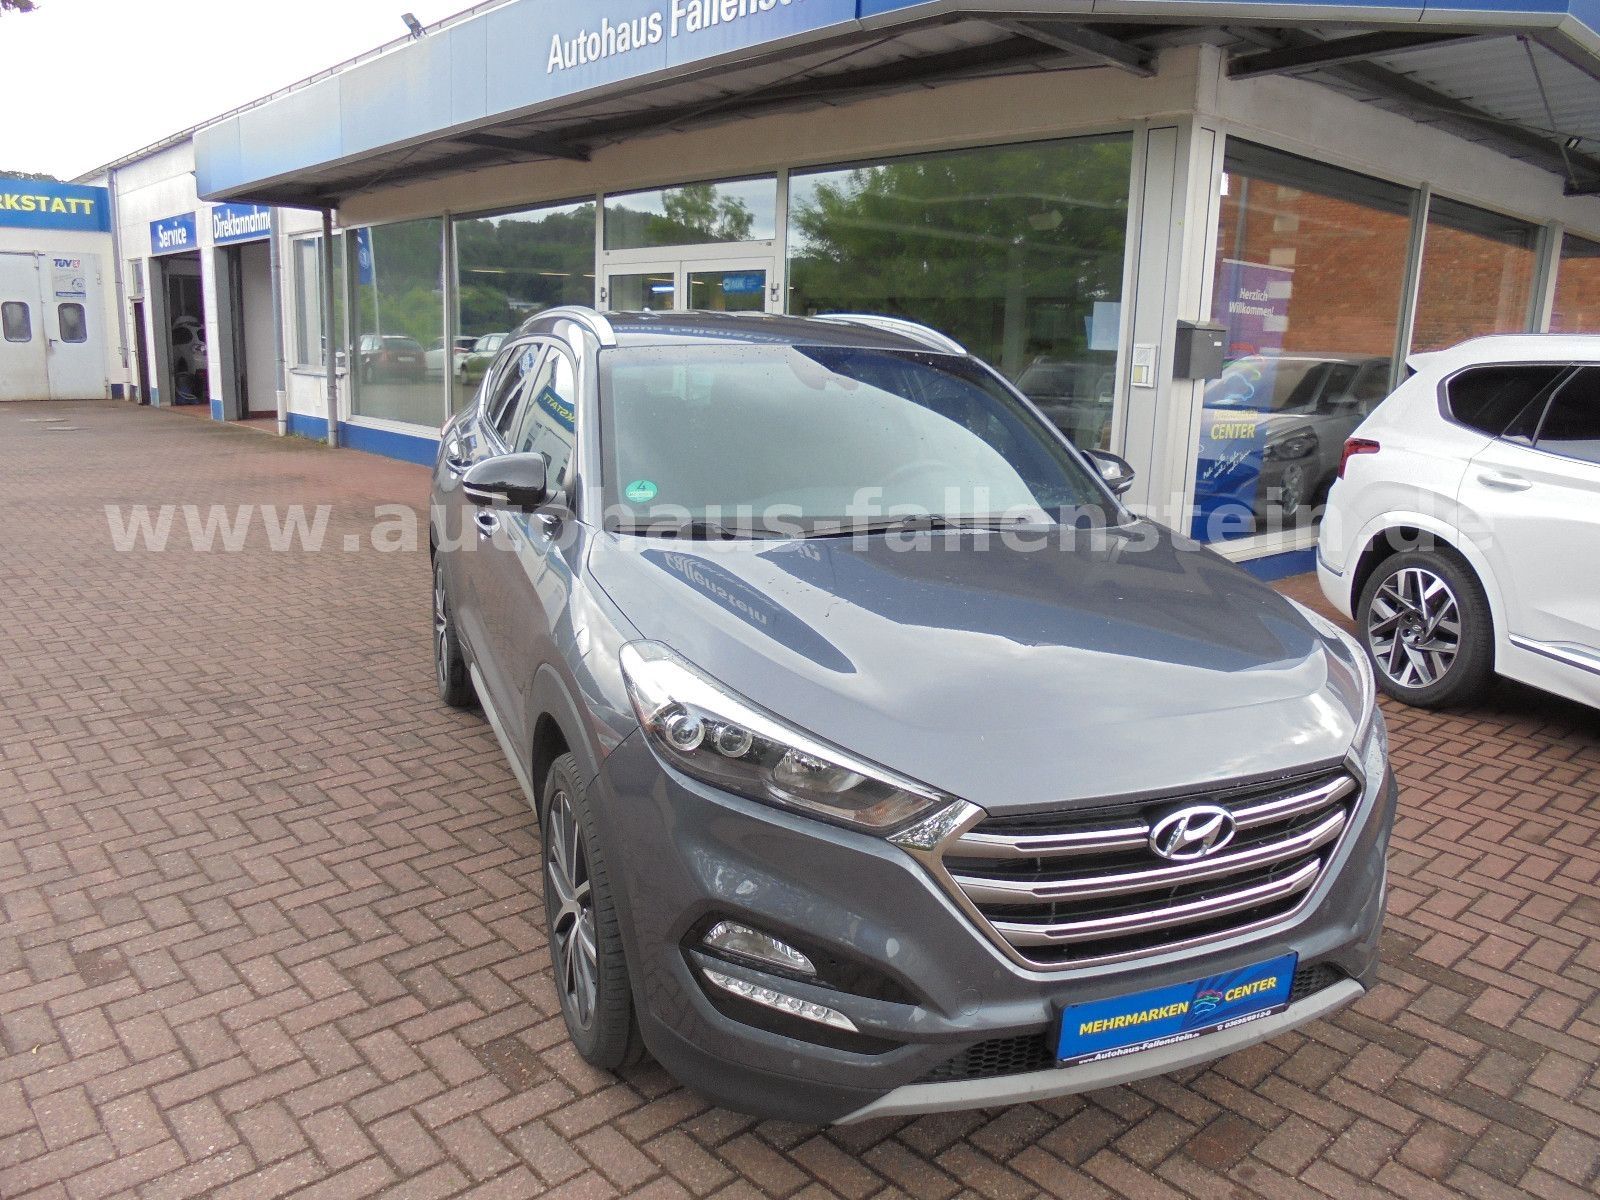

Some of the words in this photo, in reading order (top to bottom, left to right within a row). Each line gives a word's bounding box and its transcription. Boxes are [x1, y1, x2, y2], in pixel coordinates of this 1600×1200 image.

[547, 10, 663, 73] Autohaus
[671, 0, 793, 38] Fallen
[158, 220, 188, 248] Service
[1240, 287, 1269, 302] Herzlich
[1229, 301, 1275, 317] Willkommen!
[1210, 423, 1256, 440] CENTER
[1078, 1001, 1190, 1036] MEHRMARKEN
[1224, 976, 1278, 1002] CENTER
